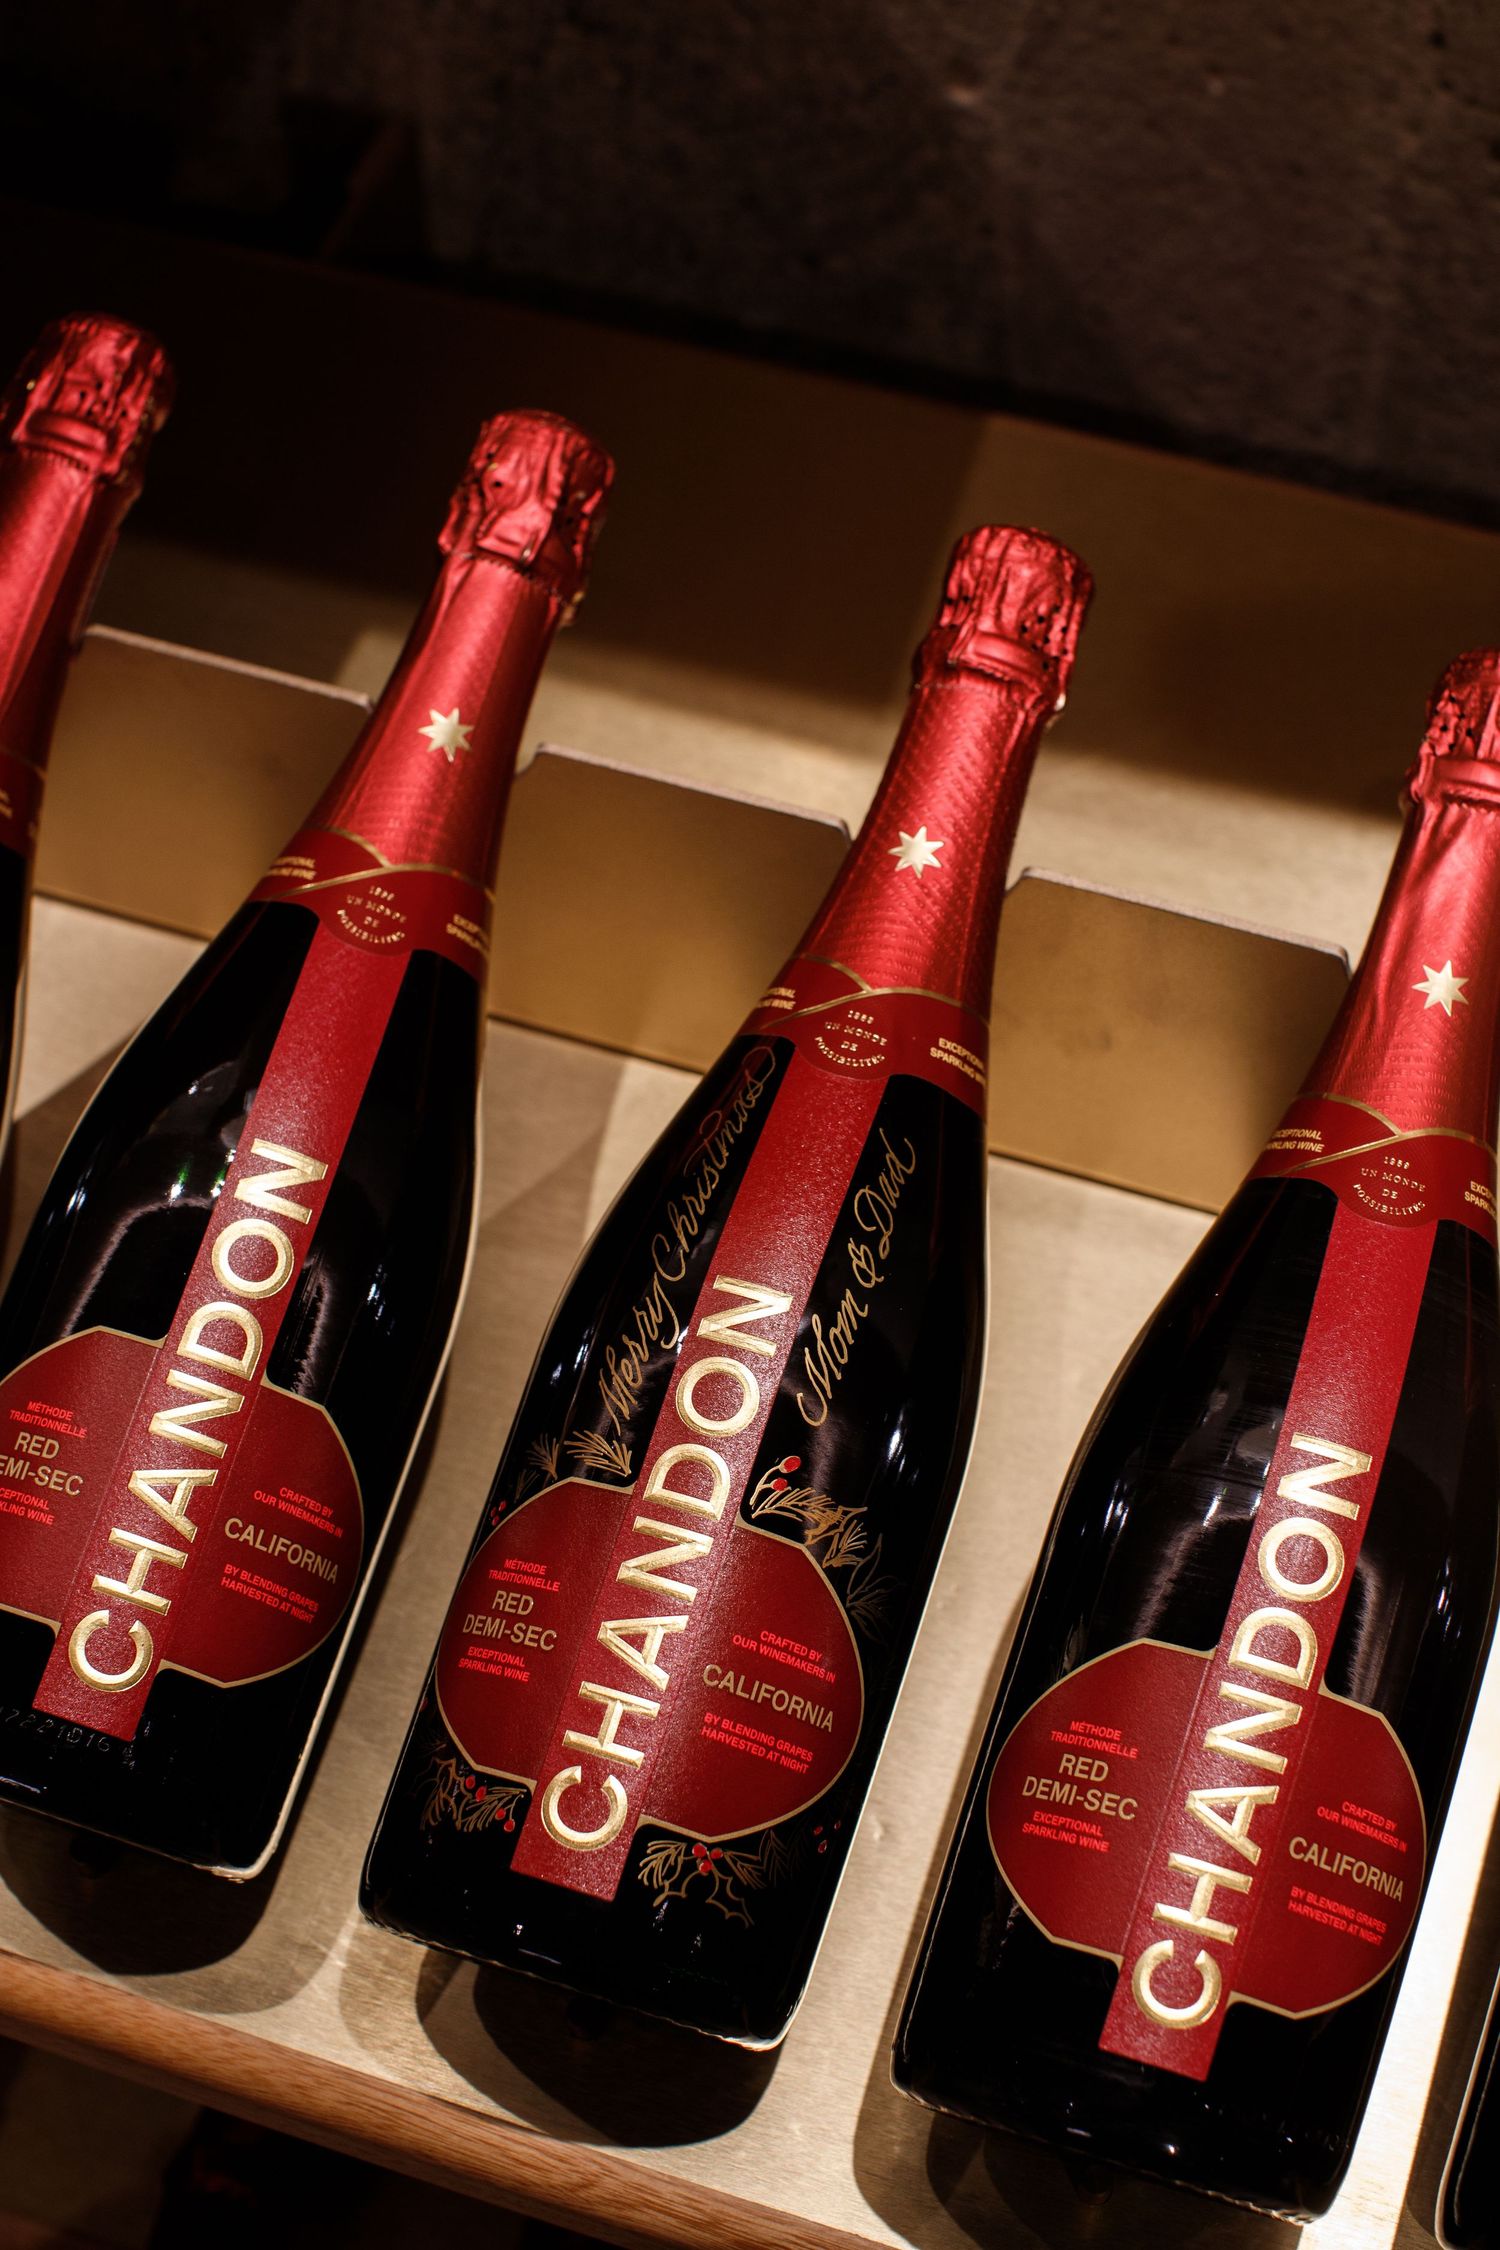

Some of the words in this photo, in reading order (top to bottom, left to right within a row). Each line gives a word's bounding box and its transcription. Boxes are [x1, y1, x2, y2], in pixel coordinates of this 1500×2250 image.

[1297, 1141, 1325, 1153] WINE
[1361, 1167, 1378, 1178] UN
[1382, 1172, 1426, 1193] MONDE
[1382, 1188, 1399, 1200] DE
[599, 1272, 680, 1436] Merry
[652, 1046, 776, 1282] Christmas
[797, 1287, 868, 1427] Mom
[854, 1128, 916, 1260] Dad
[9, 1410, 87, 1439] TRADITIONNELLE
[68, 1138, 328, 1693] CHANDON
[14, 1432, 60, 1459] RED
[0, 1455, 83, 1496] EMI-SEC
[27, 1508, 55, 1526] WINE
[254, 1490, 277, 1506] OUR
[278, 1500, 334, 1534] WINEMAKERS
[335, 1528, 343, 1538] IN
[279, 1487, 322, 1513] CRAFTED
[322, 1506, 333, 1518] BY
[224, 1517, 339, 1585] CALIFORNIA
[540, 1275, 794, 1852] CHANDON
[221, 1577, 280, 1608] HARVESTED
[280, 1602, 291, 1614] AT
[291, 1607, 315, 1624] NIGHT
[224, 1564, 240, 1576] BY
[240, 1570, 288, 1597] BLENDING
[289, 1591, 319, 1612] GRAPES
[489, 1570, 561, 1592] TRADITIONNELLE
[492, 1590, 534, 1616] RED
[463, 1614, 557, 1651] DEMI-SEC
[760, 1631, 808, 1657] CRAFTED
[809, 1649, 823, 1662] BY
[458, 1658, 502, 1676] SPARKLING
[504, 1667, 531, 1682] WINE
[468, 1646, 525, 1668] EXCEPTIONAL
[732, 1635, 758, 1651] OUR
[759, 1644, 826, 1679] WINEMAKERS
[825, 1671, 836, 1684] IN
[703, 1664, 834, 1733] CALIFORNIA
[701, 1726, 766, 1757] HARVESTED
[766, 1750, 779, 1763] AT
[779, 1755, 809, 1774] NIGHT
[704, 1712, 720, 1726] BY
[721, 1719, 775, 1746] BLENDING
[776, 1739, 814, 1762] GRAPES
[1051, 1731, 1139, 1759] TRADITIONNELLE
[1130, 1433, 1373, 2029] CHANDON
[1059, 1753, 1109, 1782] RED
[1022, 1776, 1138, 1821] DEMI-SEC
[1342, 1801, 1386, 1827] CRAFTED
[1385, 1819, 1398, 1832] BY
[1022, 1823, 1077, 1844] SPARKLING
[1079, 1835, 1110, 1852] WINE
[1033, 1811, 1103, 1838] EXCEPTIONAL
[1317, 1806, 1340, 1822] OUR
[1341, 1816, 1399, 1848] WINEMAKERS
[1398, 1842, 1407, 1853] IN
[1289, 1836, 1404, 1902] CALIFORNIA
[1288, 1900, 1347, 1931] HARVESTED
[1347, 1923, 1359, 1936] AT
[1359, 1927, 1383, 1946] NIGHT
[1291, 1886, 1305, 1899] BY
[1306, 1892, 1355, 1920] BLENDING
[1356, 1912, 1387, 1933] GRAPES
